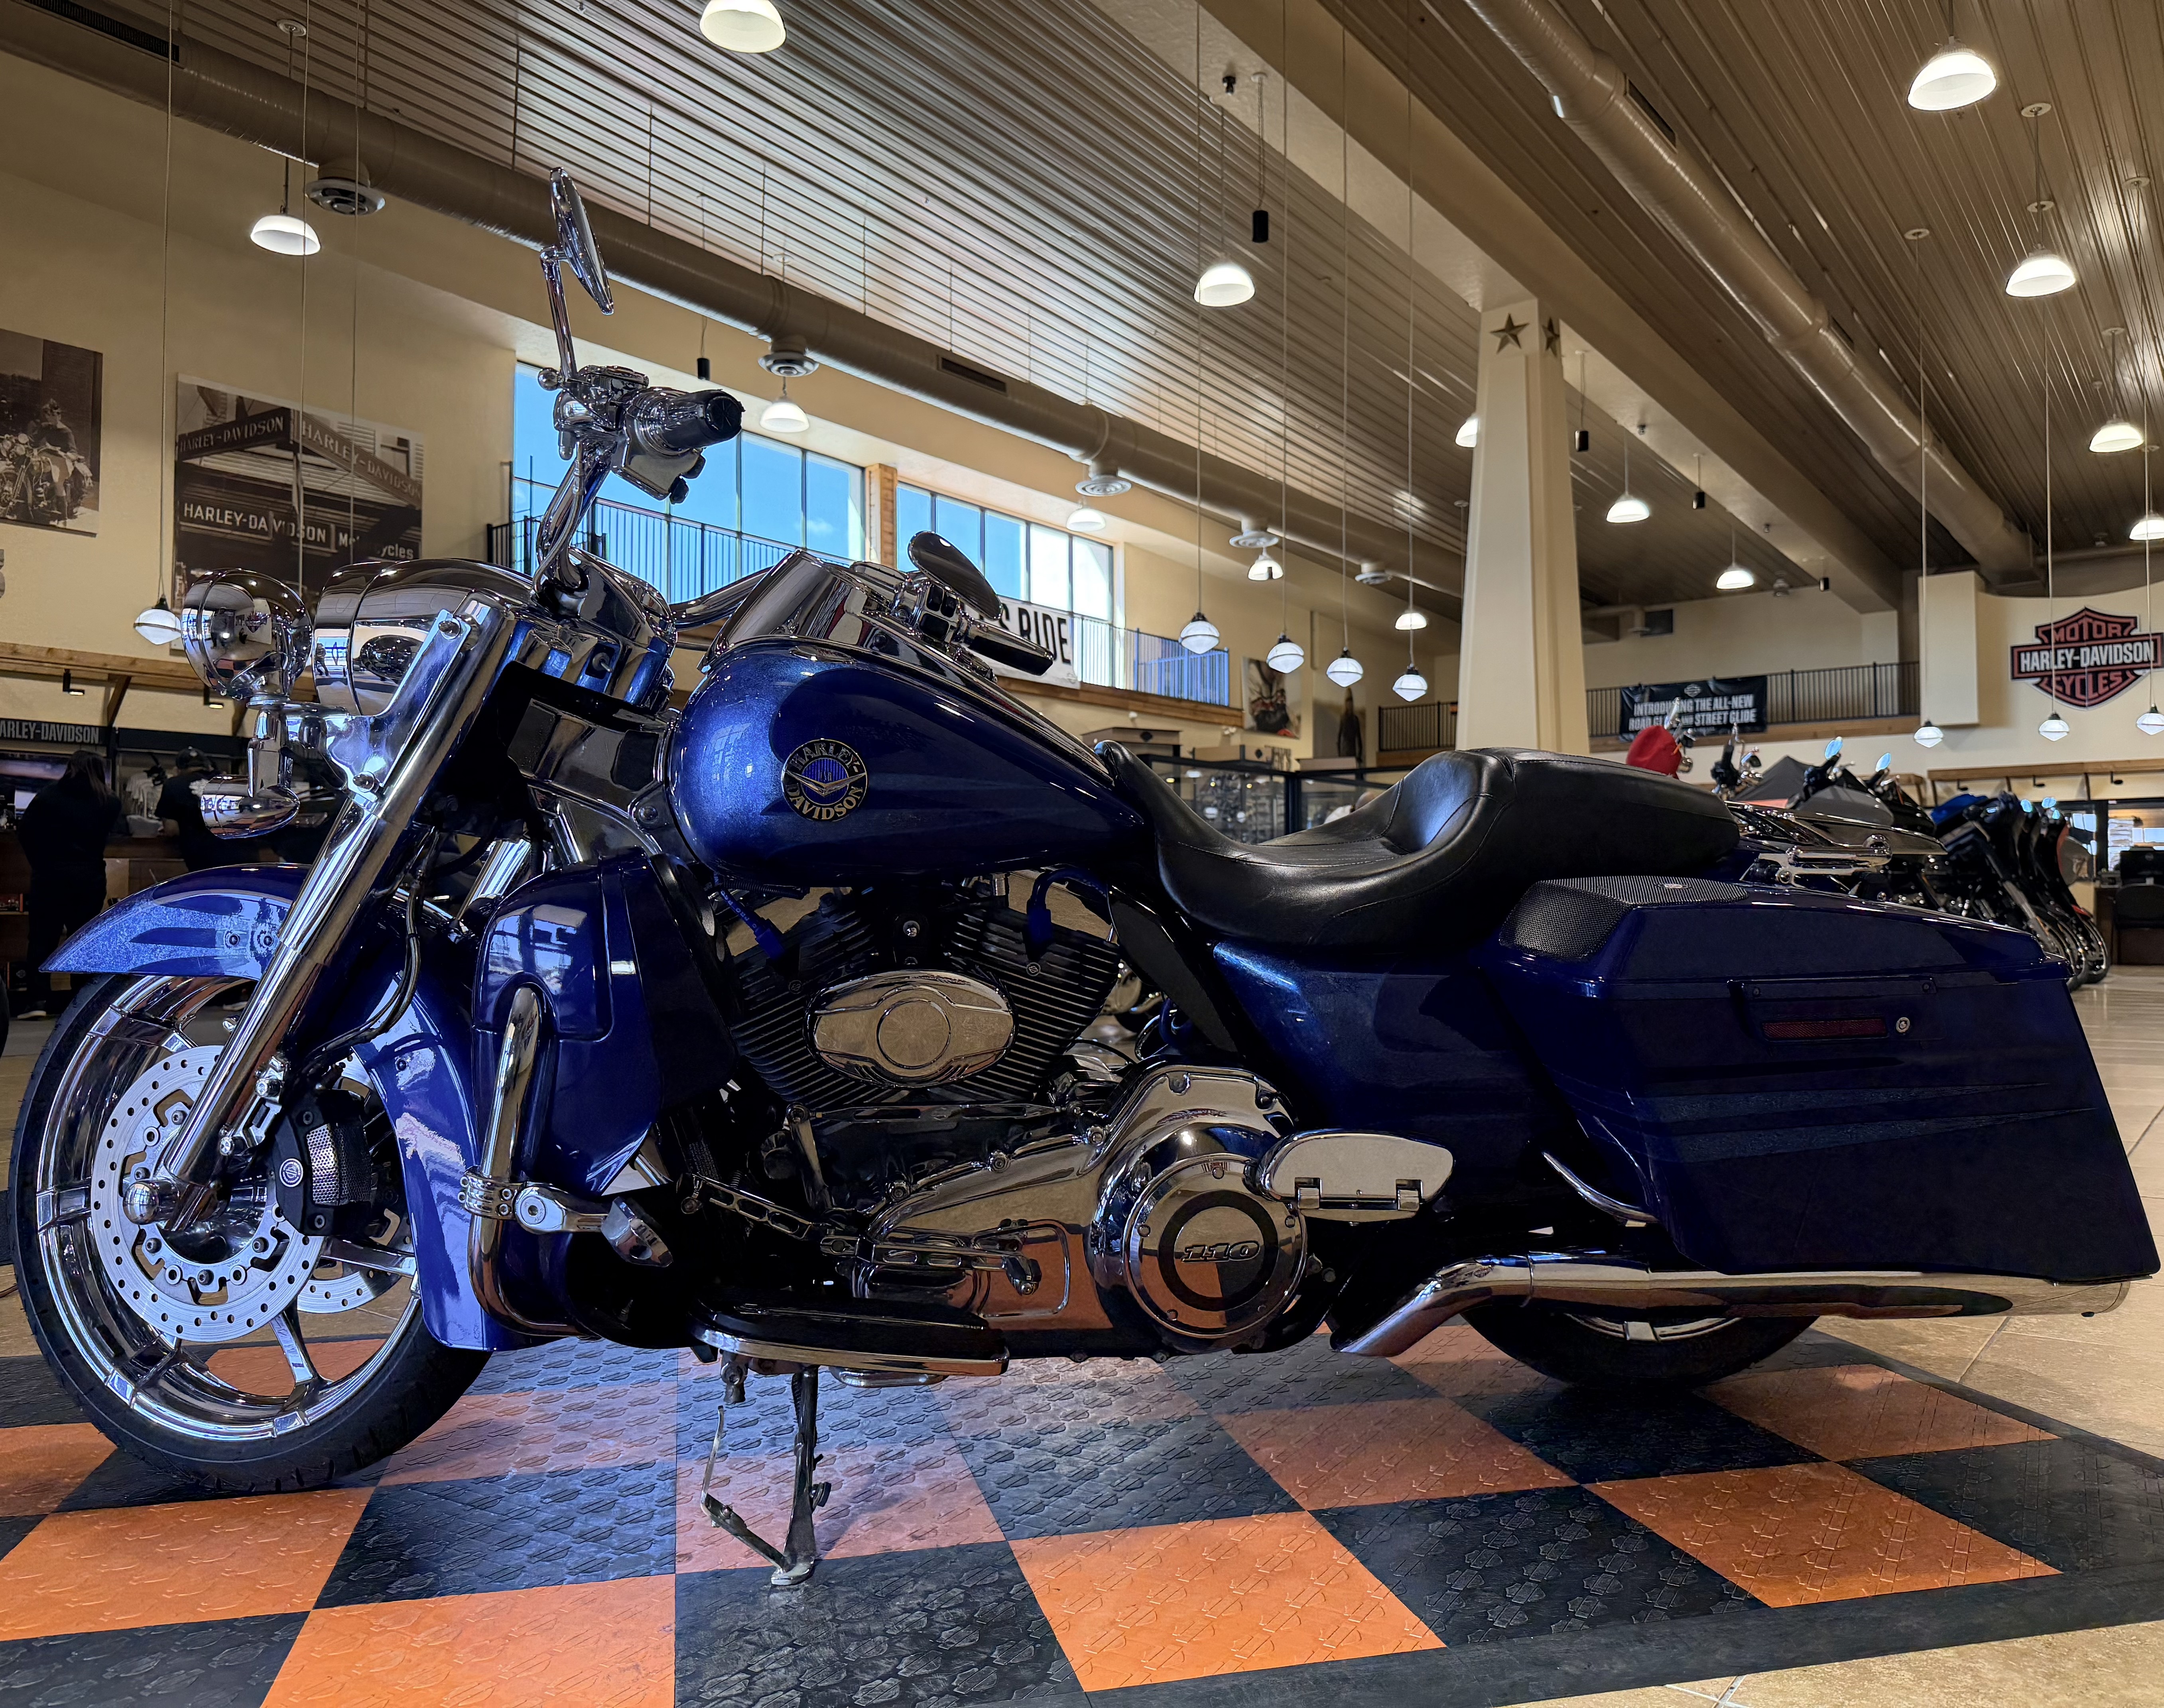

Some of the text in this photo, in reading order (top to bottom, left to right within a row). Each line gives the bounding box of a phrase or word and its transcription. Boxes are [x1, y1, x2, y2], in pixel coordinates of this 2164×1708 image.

[179, 416, 284, 452] HARLEY-DAVIDSON
[1018, 607, 1071, 665] RIDE
[2052, 616, 2122, 643] MOTOR
[2020, 640, 2153, 672] HARLEY-DAVIDSON
[2052, 671, 2123, 701] CYCLES
[1695, 697, 1713, 712] THE
[1713, 694, 1754, 710] ALL-NEW
[1695, 708, 1757, 727] STREET GLIDE
[786, 783, 863, 820] DAVIDSON
[1181, 1240, 1260, 1263] 110
